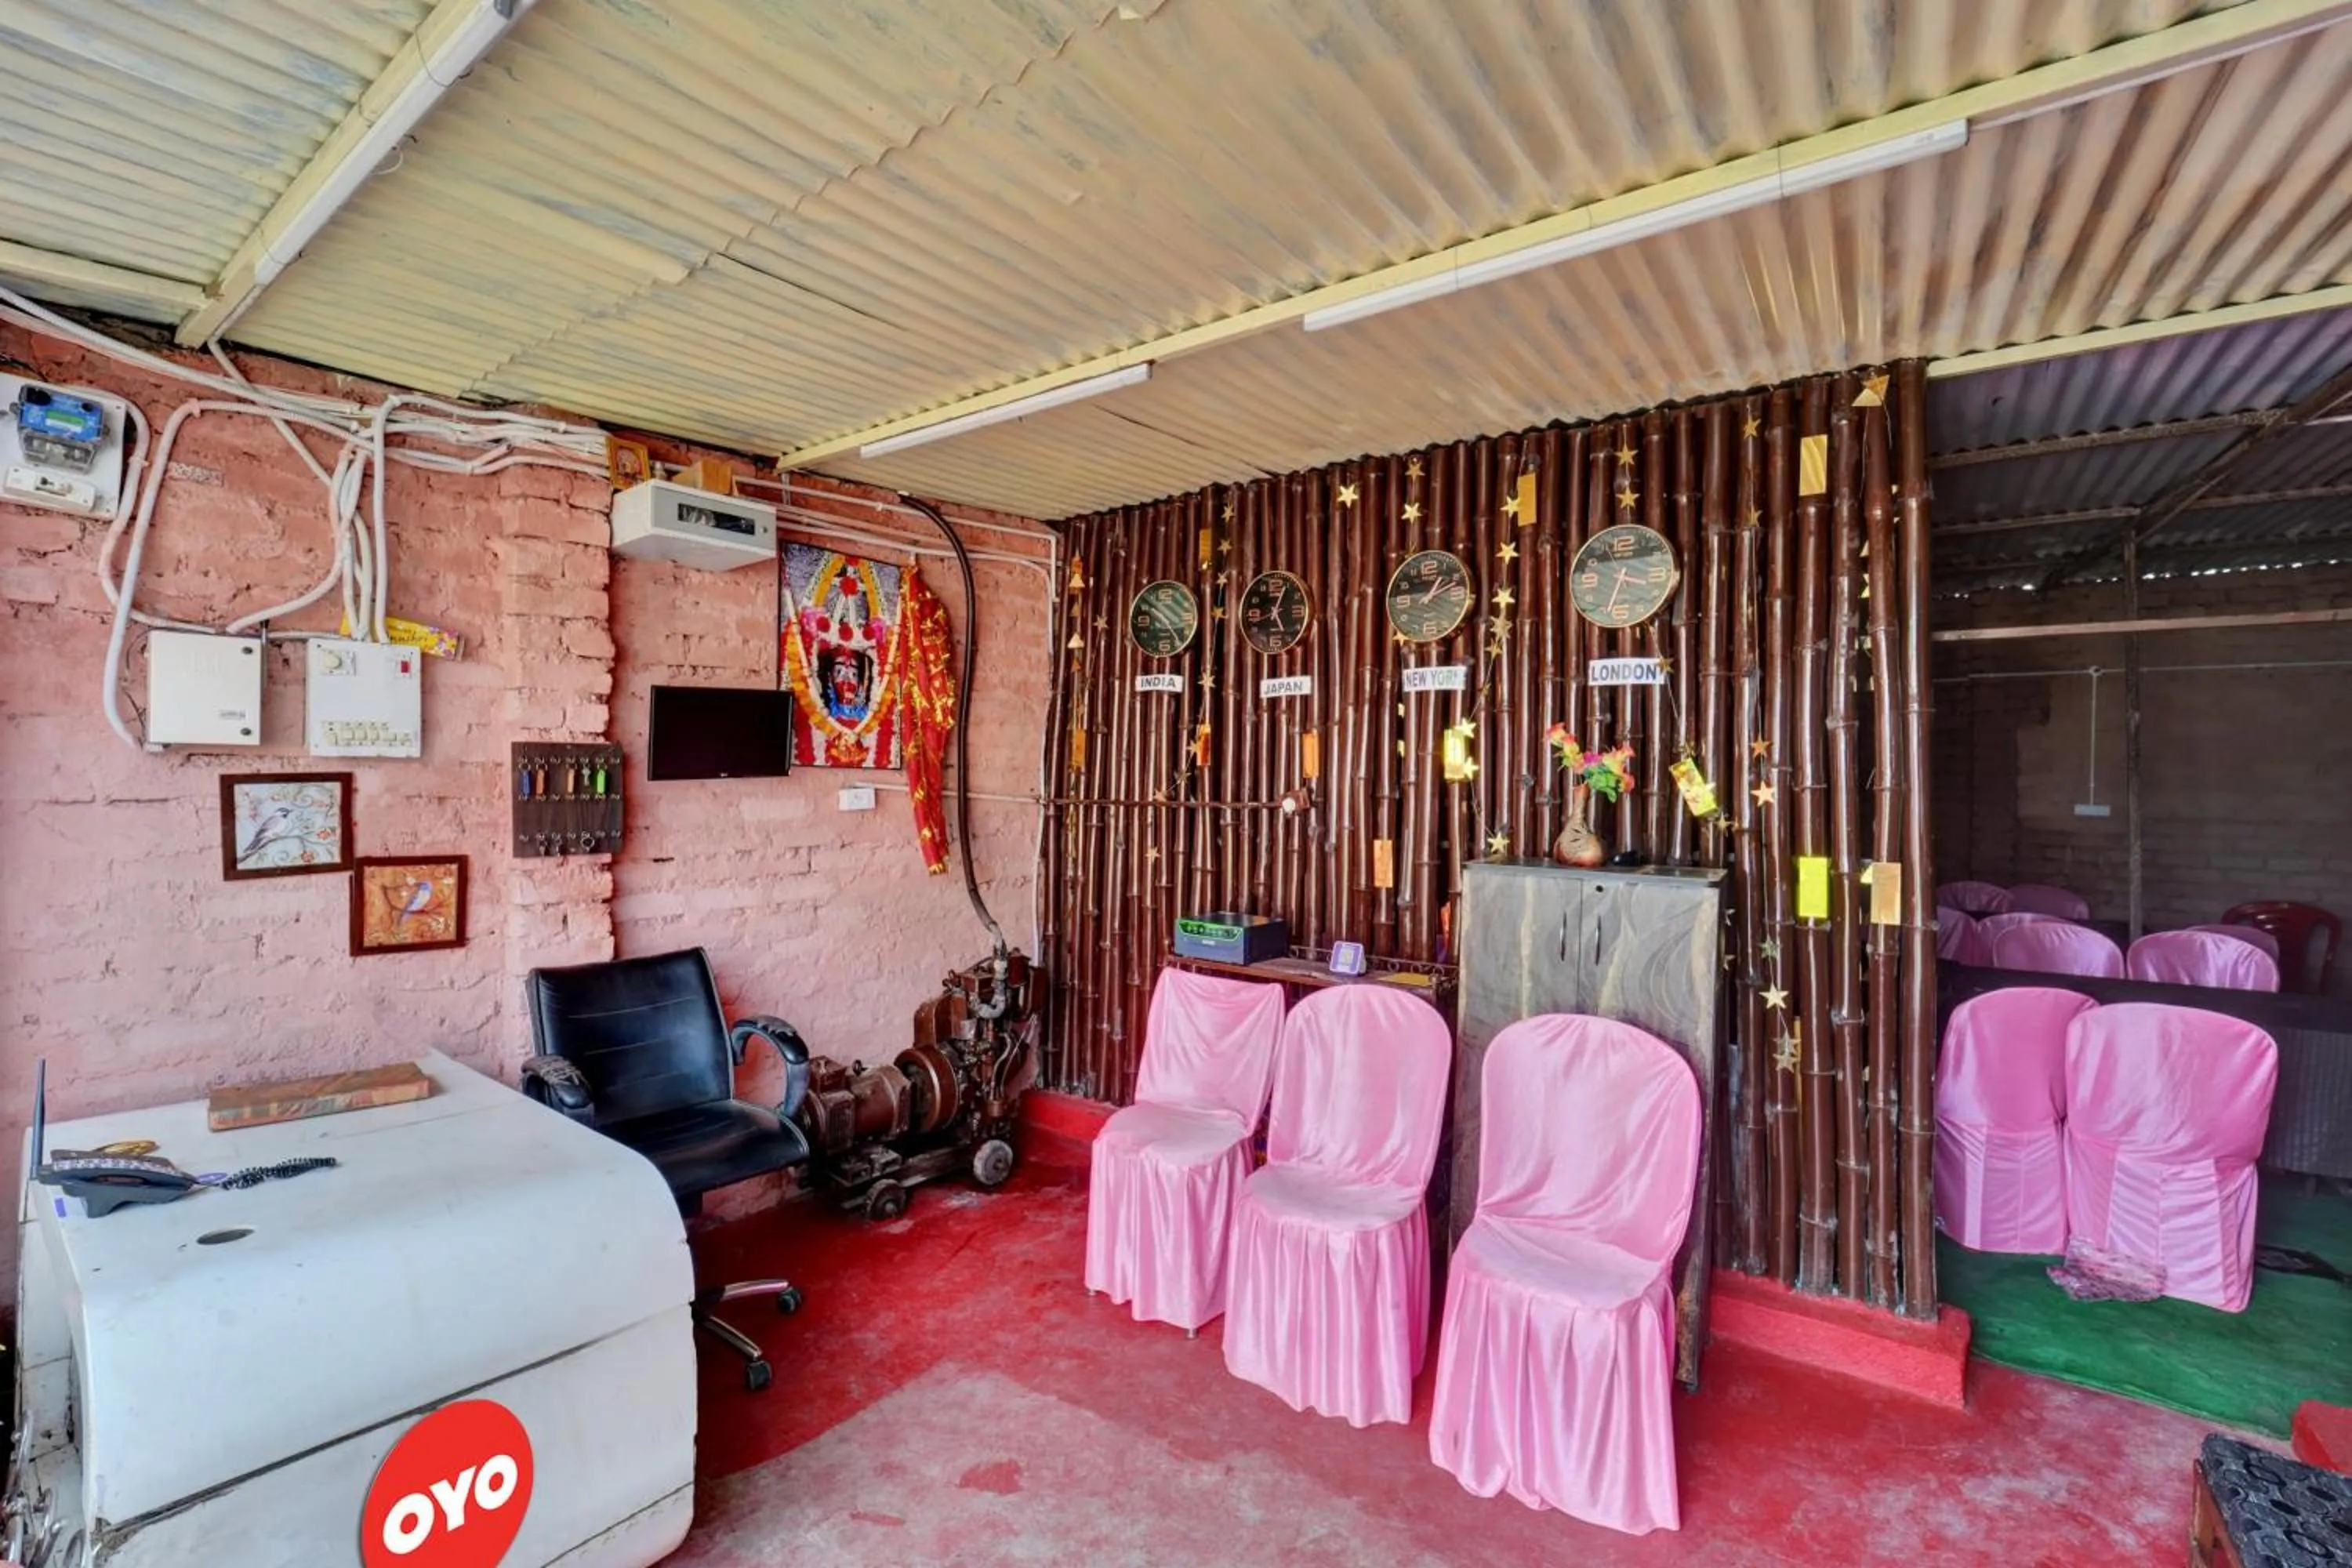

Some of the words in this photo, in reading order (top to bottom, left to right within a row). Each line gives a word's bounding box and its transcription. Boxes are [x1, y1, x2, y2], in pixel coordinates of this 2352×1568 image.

[1581, 572, 1599, 588] 9
[1648, 566, 1667, 583] 3
[1396, 594, 1411, 609] 9
[1404, 671, 1427, 688] NEW
[1591, 663, 1657, 681] LONDON
[1140, 677, 1177, 688] INDIA
[1263, 680, 1304, 695] JAPAN
[382, 1454, 518, 1555] OYO
